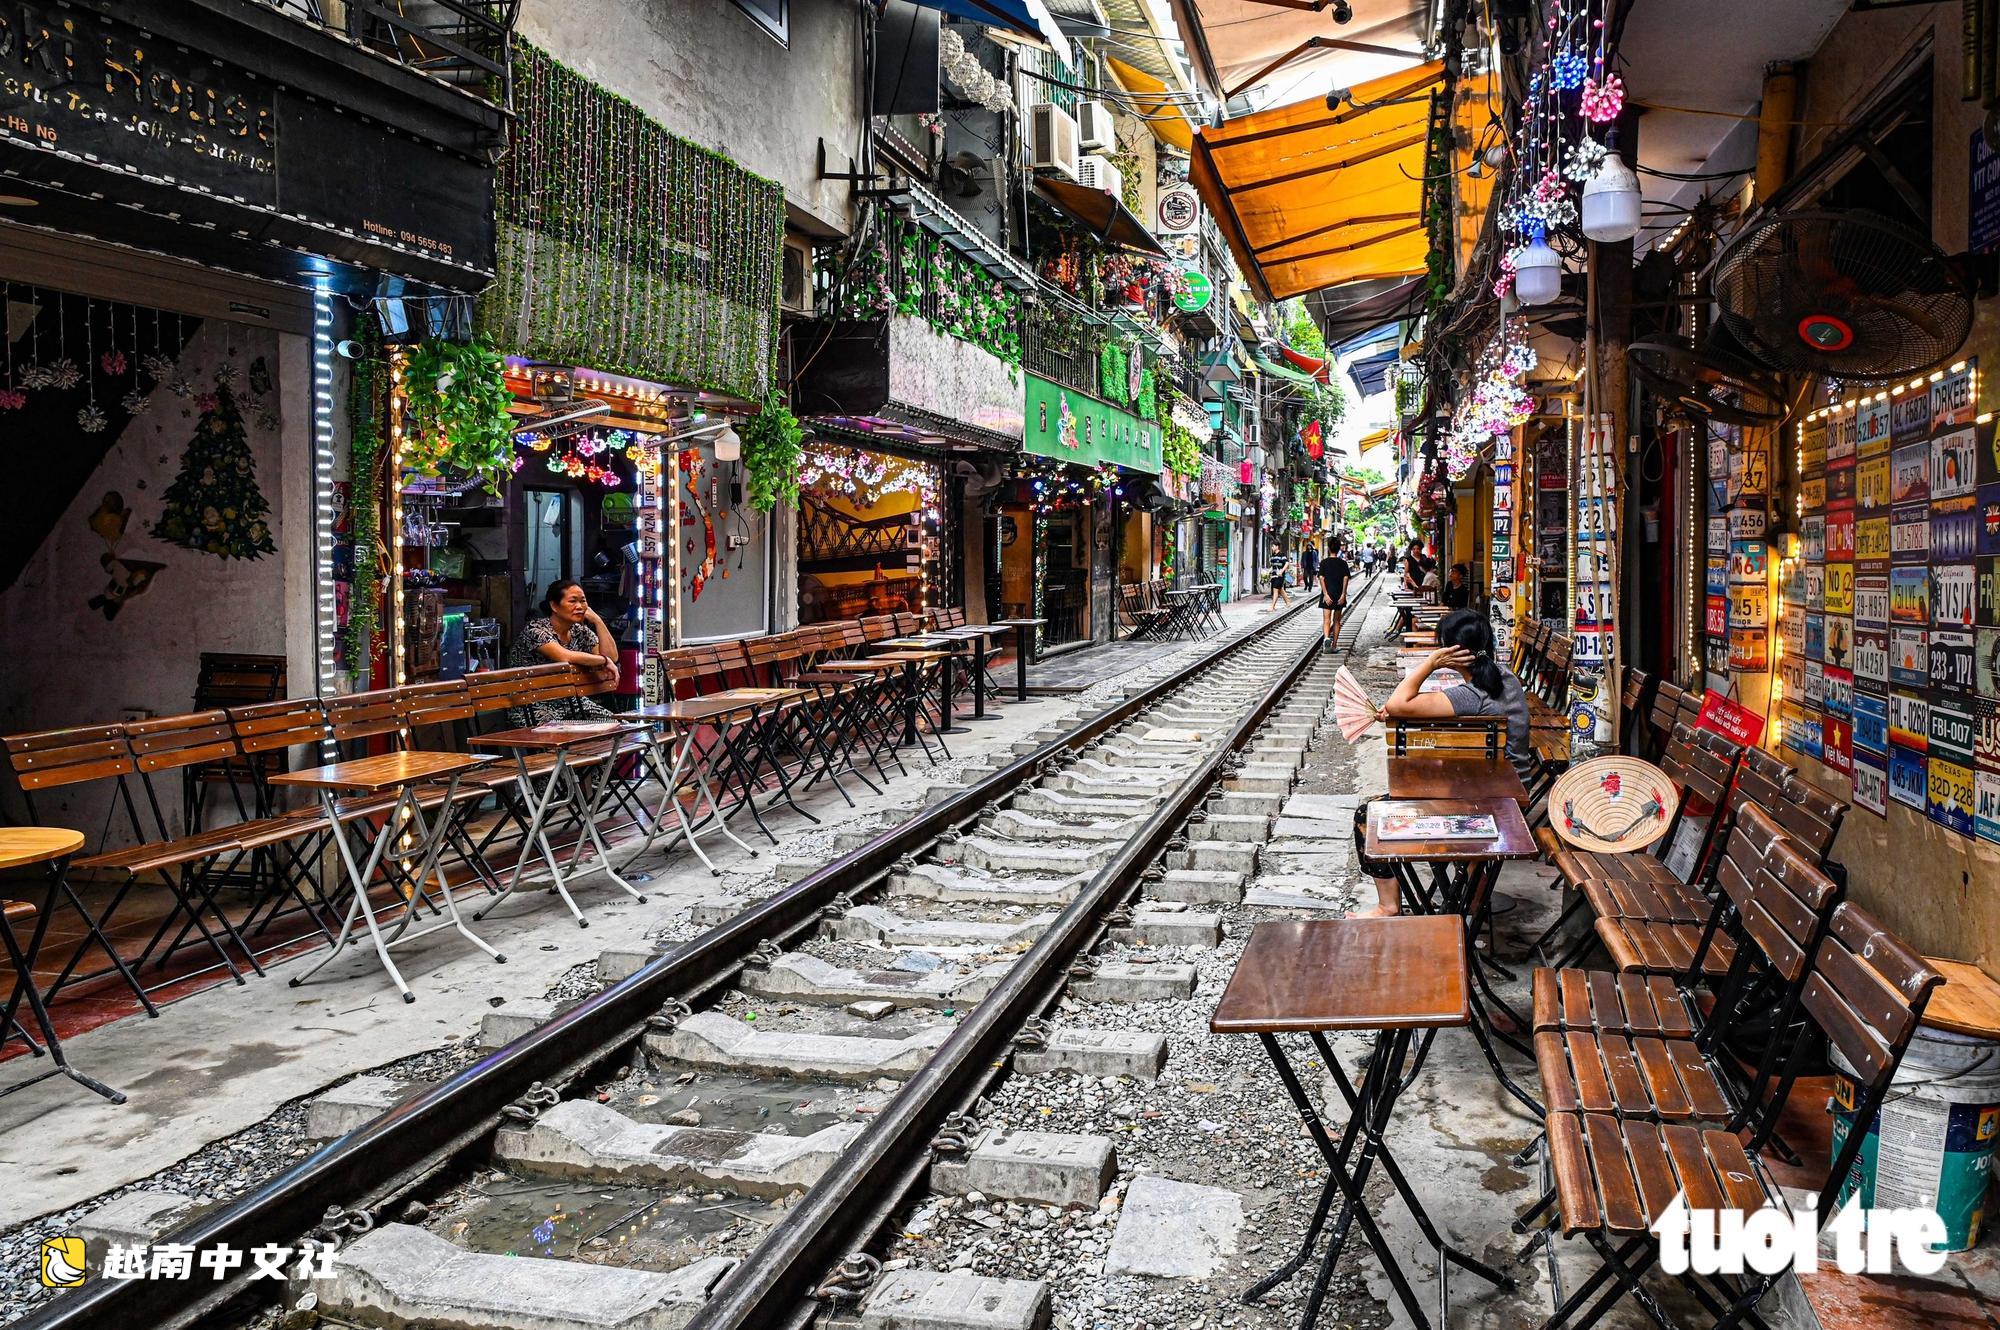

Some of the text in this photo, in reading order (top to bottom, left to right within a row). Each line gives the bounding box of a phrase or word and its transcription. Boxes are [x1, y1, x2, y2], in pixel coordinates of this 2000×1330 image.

[1829, 570, 1840, 592] NO
[1931, 716, 1970, 744] FBI-007
[1836, 748, 1850, 769] Nam
[1930, 774, 1951, 798] 32D
[1953, 783, 1973, 808] 228
